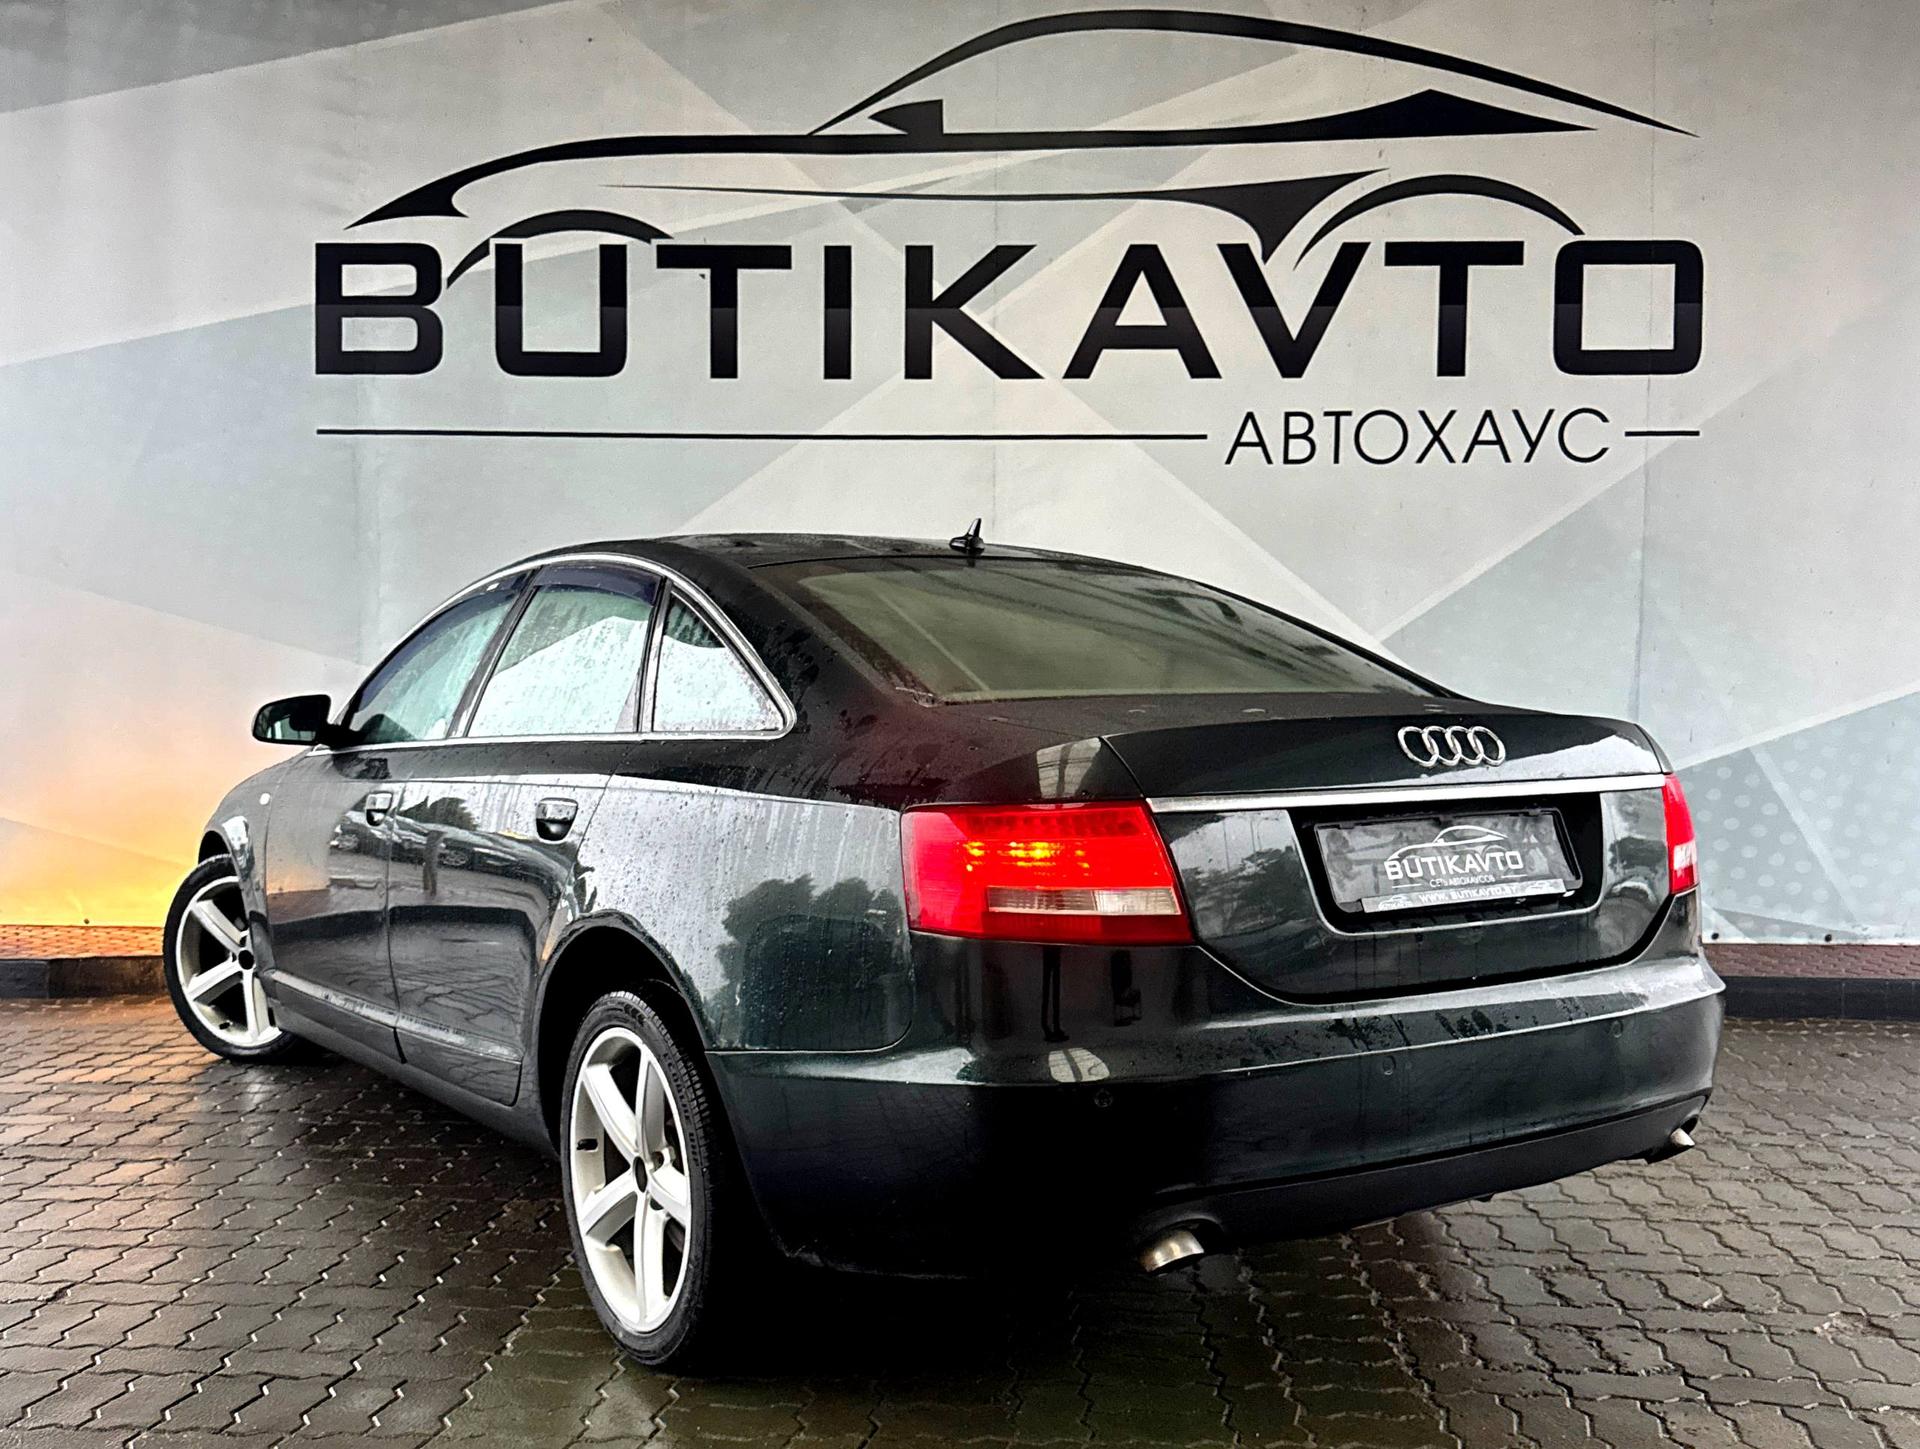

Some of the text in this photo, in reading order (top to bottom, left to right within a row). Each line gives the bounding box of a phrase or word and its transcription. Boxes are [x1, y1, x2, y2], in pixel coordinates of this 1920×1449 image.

[315, 240, 1704, 380] BUTIKAVTO
[1224, 408, 1611, 465] АВТОХАУС
[1384, 850, 1524, 881] BUTIKAVTO
